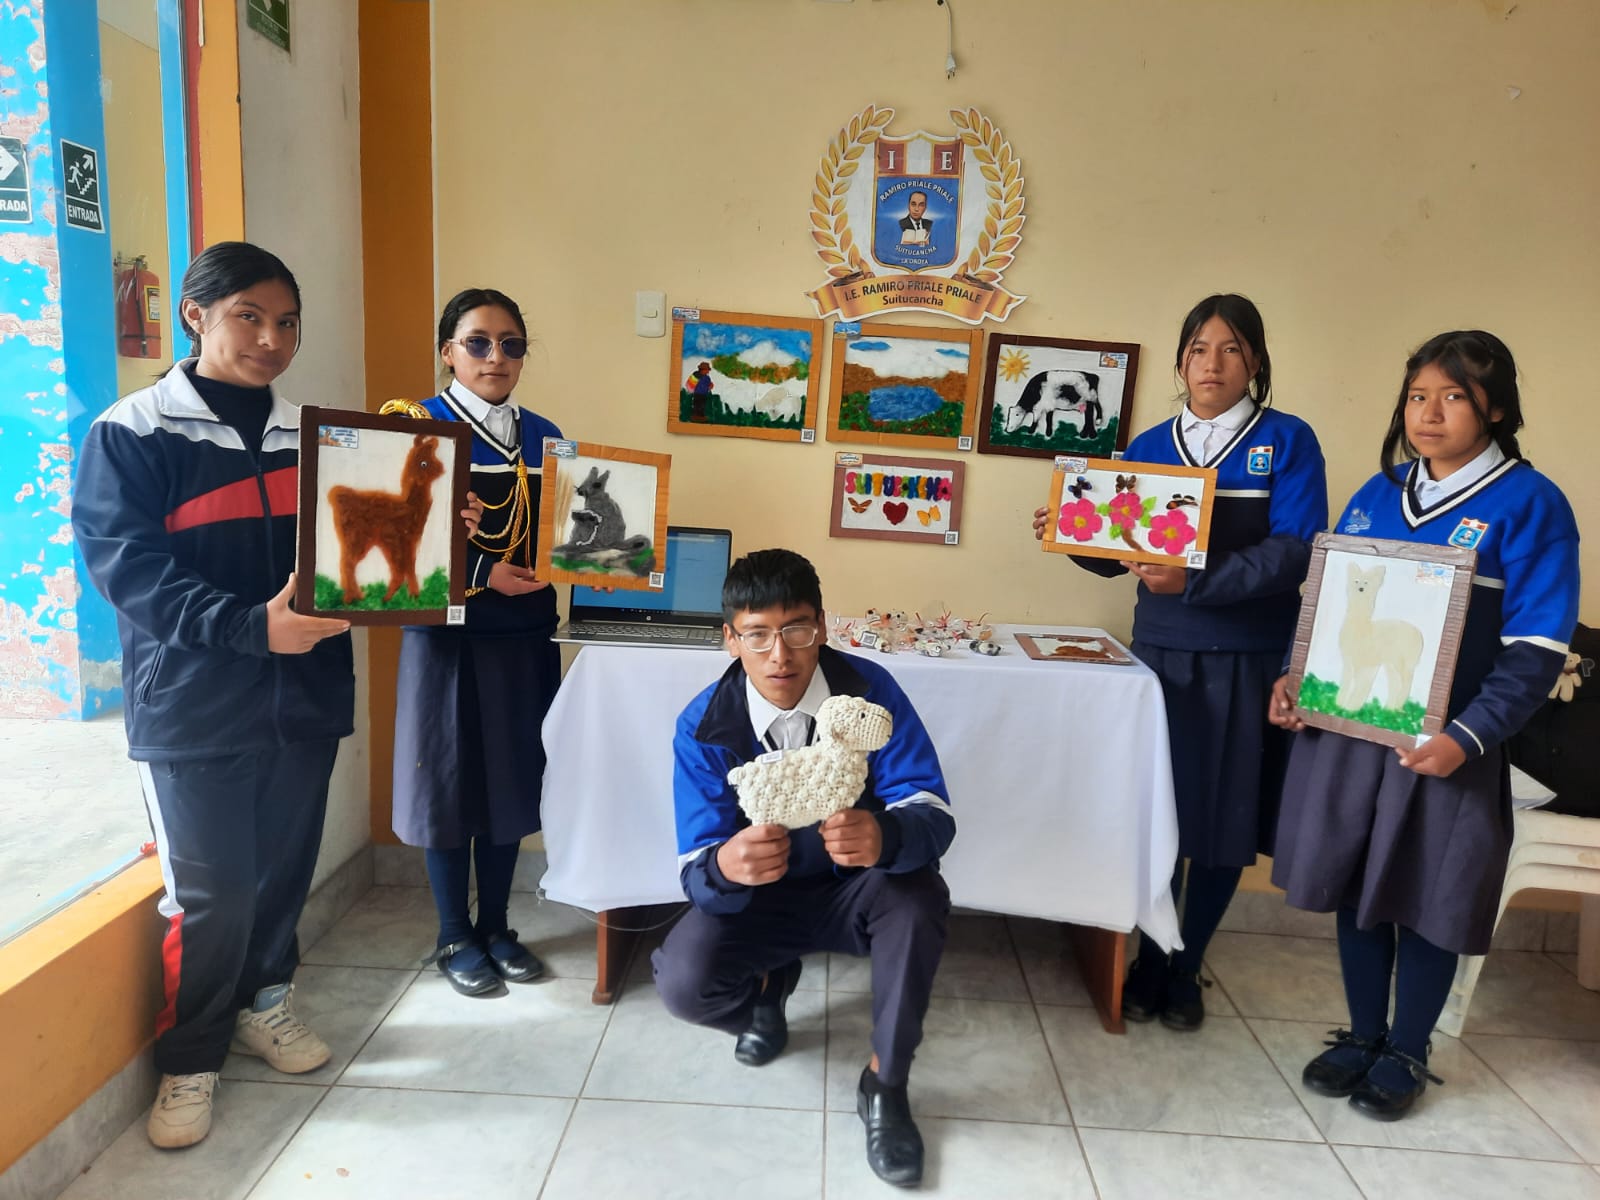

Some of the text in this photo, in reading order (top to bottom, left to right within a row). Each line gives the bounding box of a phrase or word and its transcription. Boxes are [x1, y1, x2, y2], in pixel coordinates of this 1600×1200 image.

[888, 150, 953, 171] I E
[880, 180, 955, 204] RAMIRO PRIALE PRIALE
[68, 205, 99, 223] ENTRADA
[895, 244, 937, 256] SUITUCANCHA
[844, 280, 982, 305] I.E. RAMIRO PRIALE PRIALE
[882, 295, 944, 306] Suitucancha
